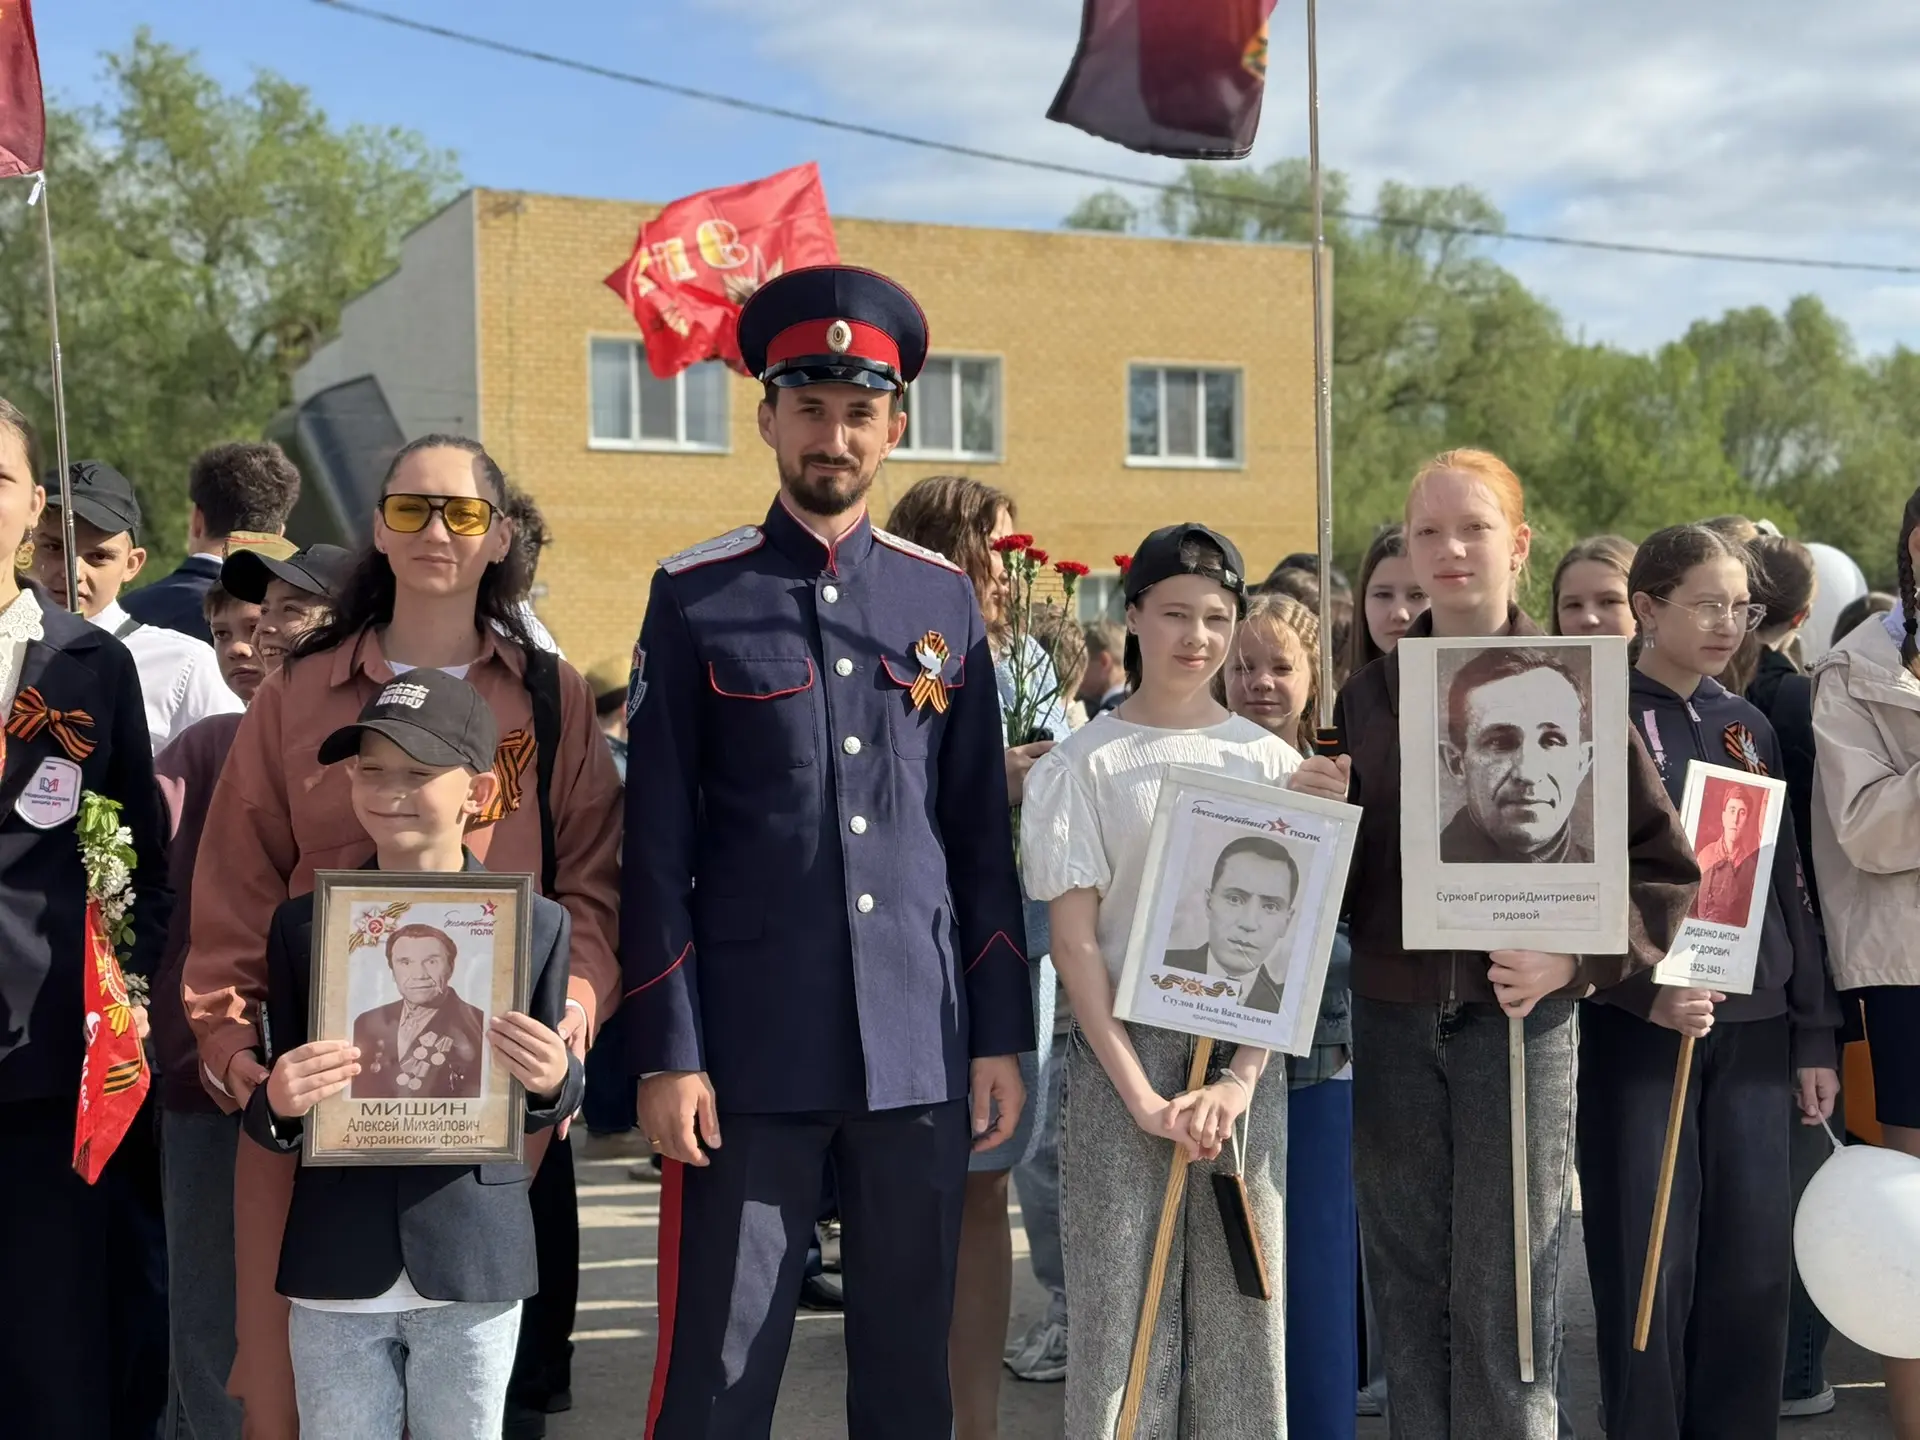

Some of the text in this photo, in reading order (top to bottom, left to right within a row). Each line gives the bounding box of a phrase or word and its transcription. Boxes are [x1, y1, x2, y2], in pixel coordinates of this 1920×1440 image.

[1436, 891, 1596, 903] СурковГригорийДмитриевич
[1492, 910, 1540, 921] рядовой
[1685, 926, 1740, 942] ДИДЕНКО АНТОН
[1690, 963, 1721, 975] 1925-1943
[1162, 994, 1195, 1009] Стулов
[1195, 1001, 1219, 1015] Илья
[361, 1102, 467, 1116] МИШИН
[346, 1117, 480, 1132] Алексей Михайлович
[342, 1133, 486, 1147] 4 украинский фронт
